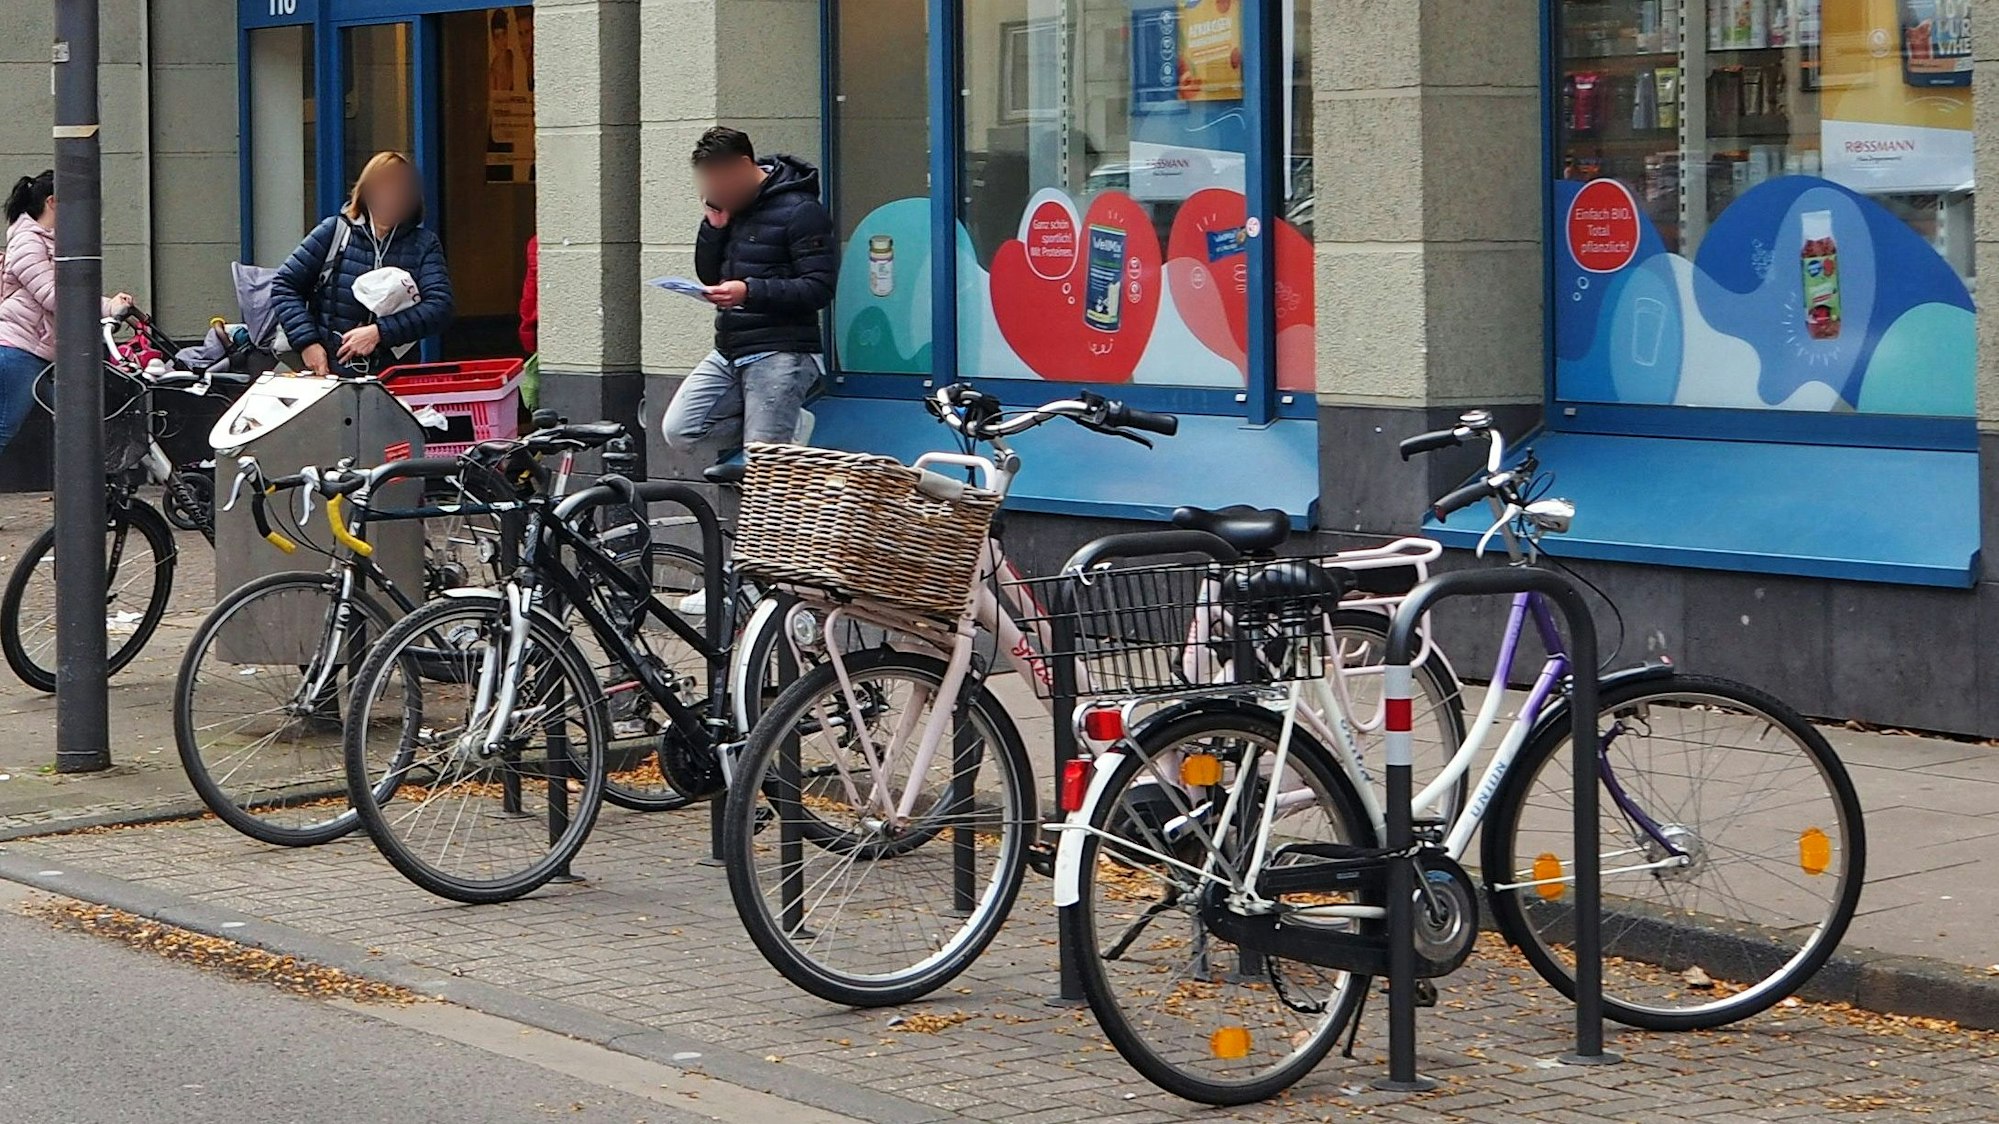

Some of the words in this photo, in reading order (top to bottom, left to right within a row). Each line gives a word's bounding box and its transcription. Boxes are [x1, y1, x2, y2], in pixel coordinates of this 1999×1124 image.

[1844, 140, 1915, 153] ROSSMANN
[1575, 207, 1609, 220] Einfach
[1611, 207, 1632, 220] BIO.
[1032, 219, 1050, 230] Ganz
[1587, 224, 1610, 236] Total
[1581, 240, 1630, 256] pflanzlich!
[1470, 761, 1507, 818] UNION
